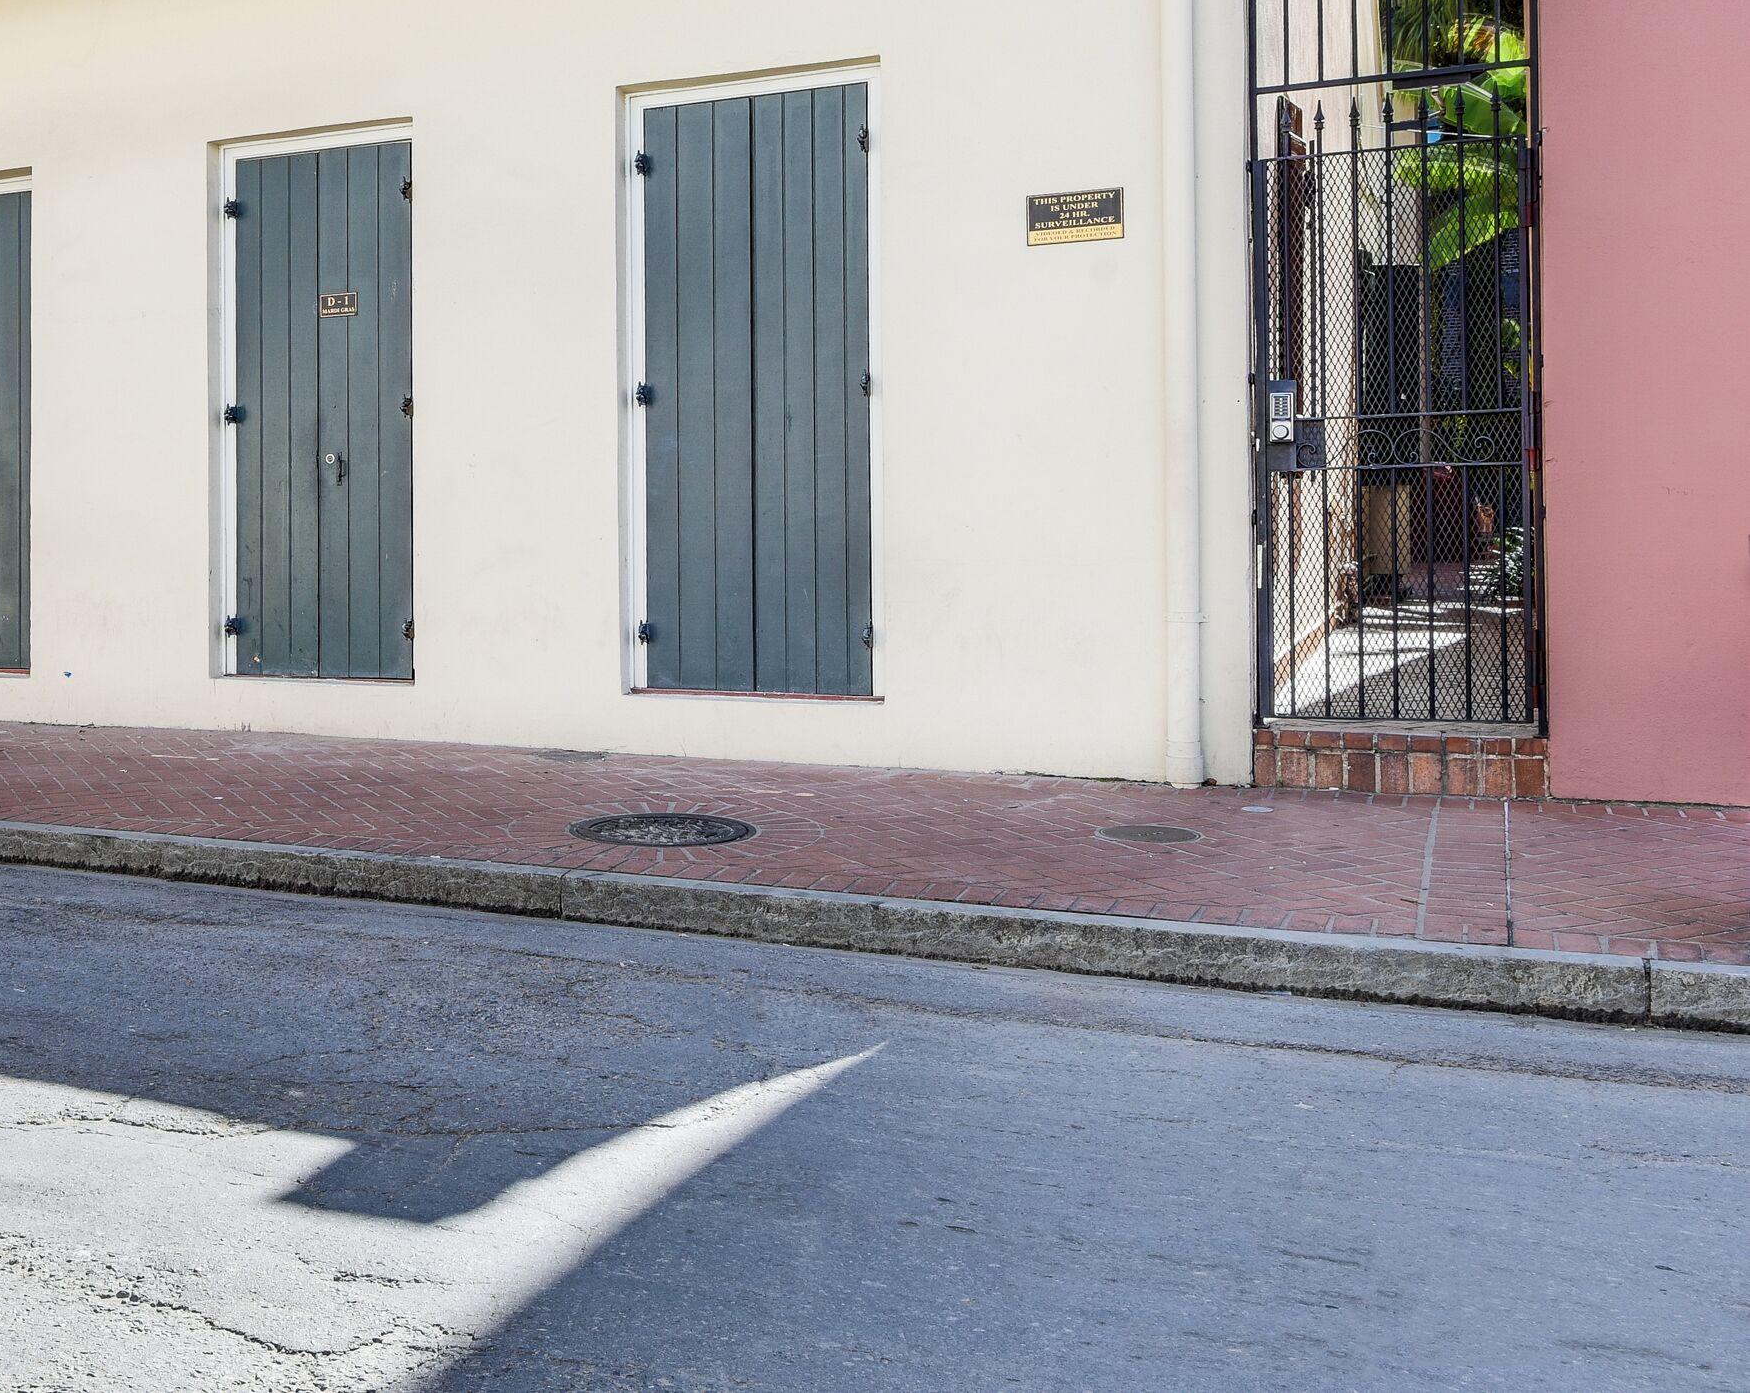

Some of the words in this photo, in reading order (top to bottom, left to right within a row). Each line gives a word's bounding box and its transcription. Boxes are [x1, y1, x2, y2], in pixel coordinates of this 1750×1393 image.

[1033, 197, 1058, 205] THIS
[1060, 191, 1115, 203] PROPERTY
[1062, 202, 1099, 210] UNDER
[1035, 215, 1115, 229] SURVEILLANCE
[1070, 231, 1116, 239] PROTECTION
